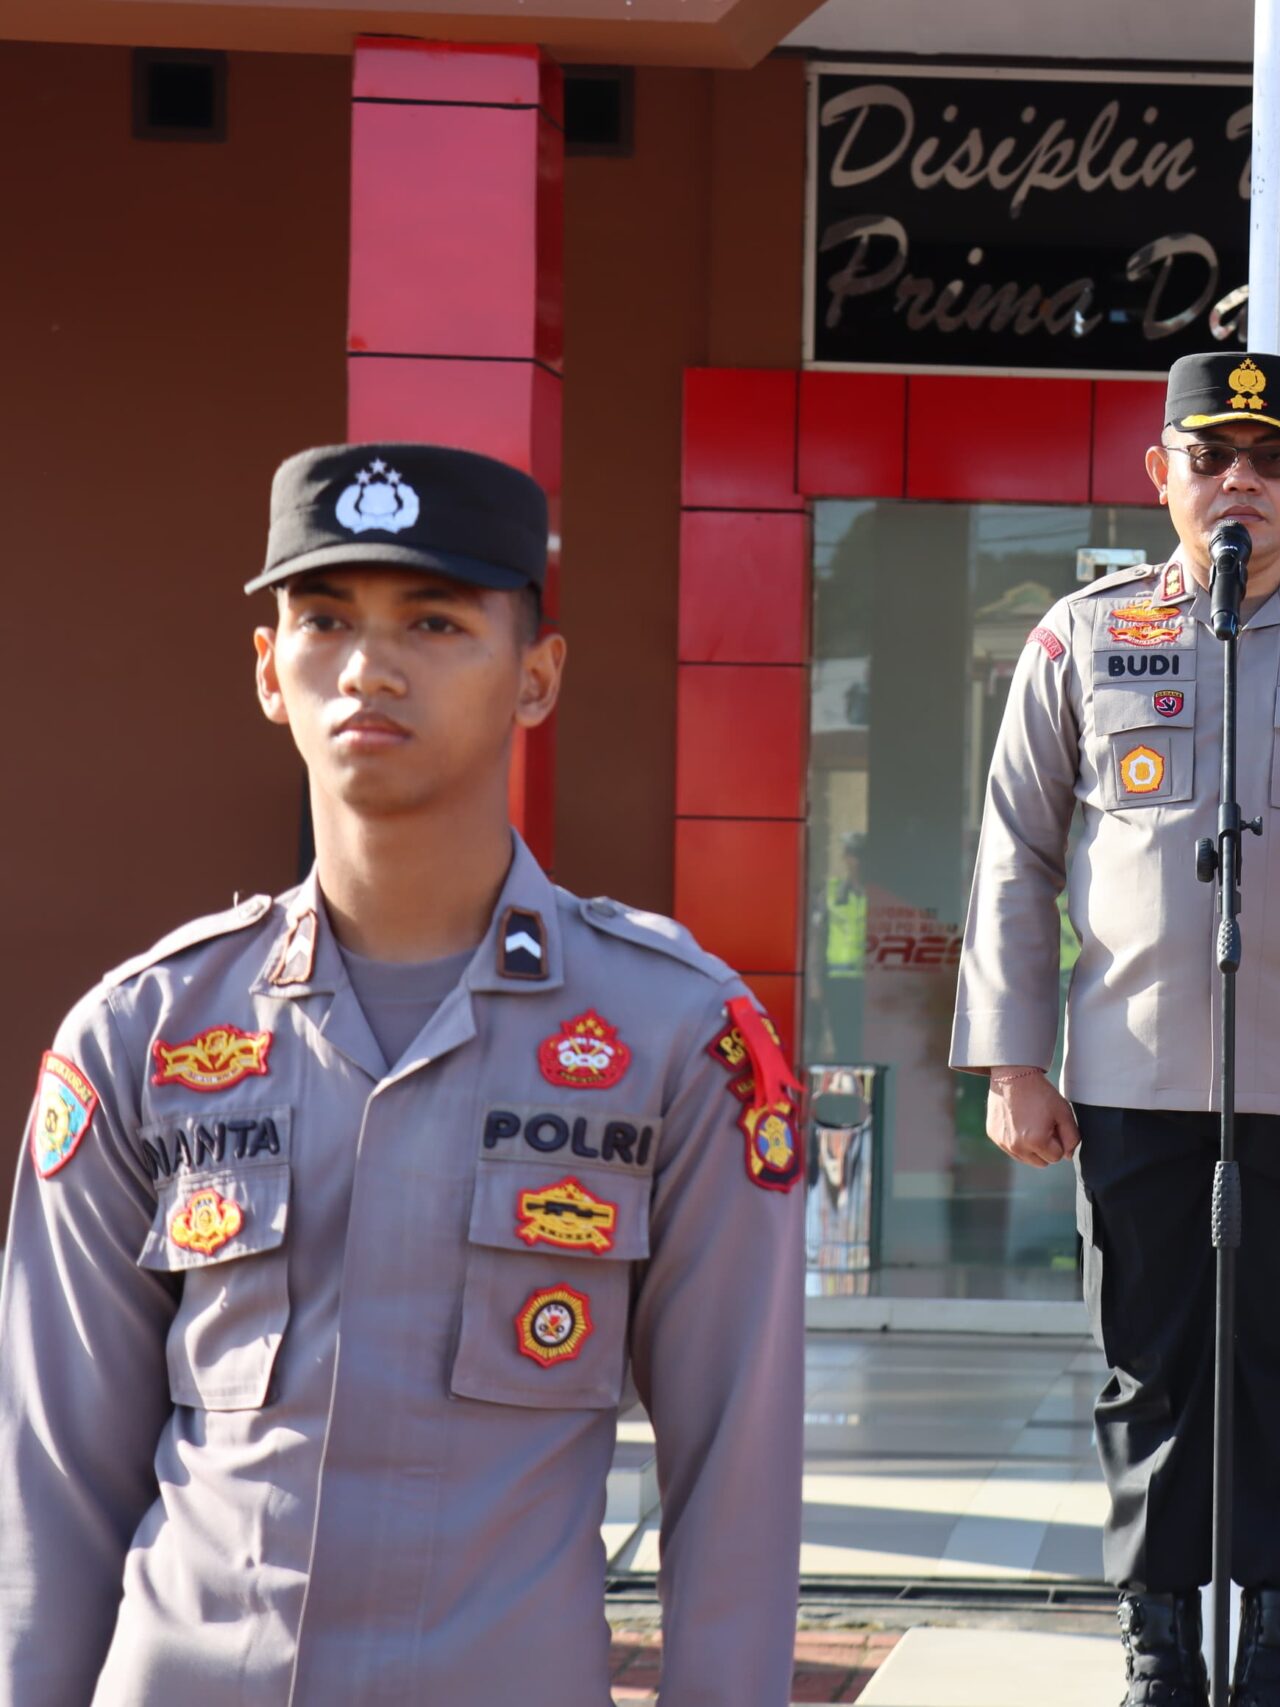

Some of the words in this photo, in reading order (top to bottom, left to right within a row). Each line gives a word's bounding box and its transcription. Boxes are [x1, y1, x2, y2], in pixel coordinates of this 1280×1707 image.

[821, 85, 1196, 218] Disiplin
[821, 214, 1102, 335] Prima
[1108, 655, 1180, 677] BUDI
[483, 1110, 654, 1166] POLRI
